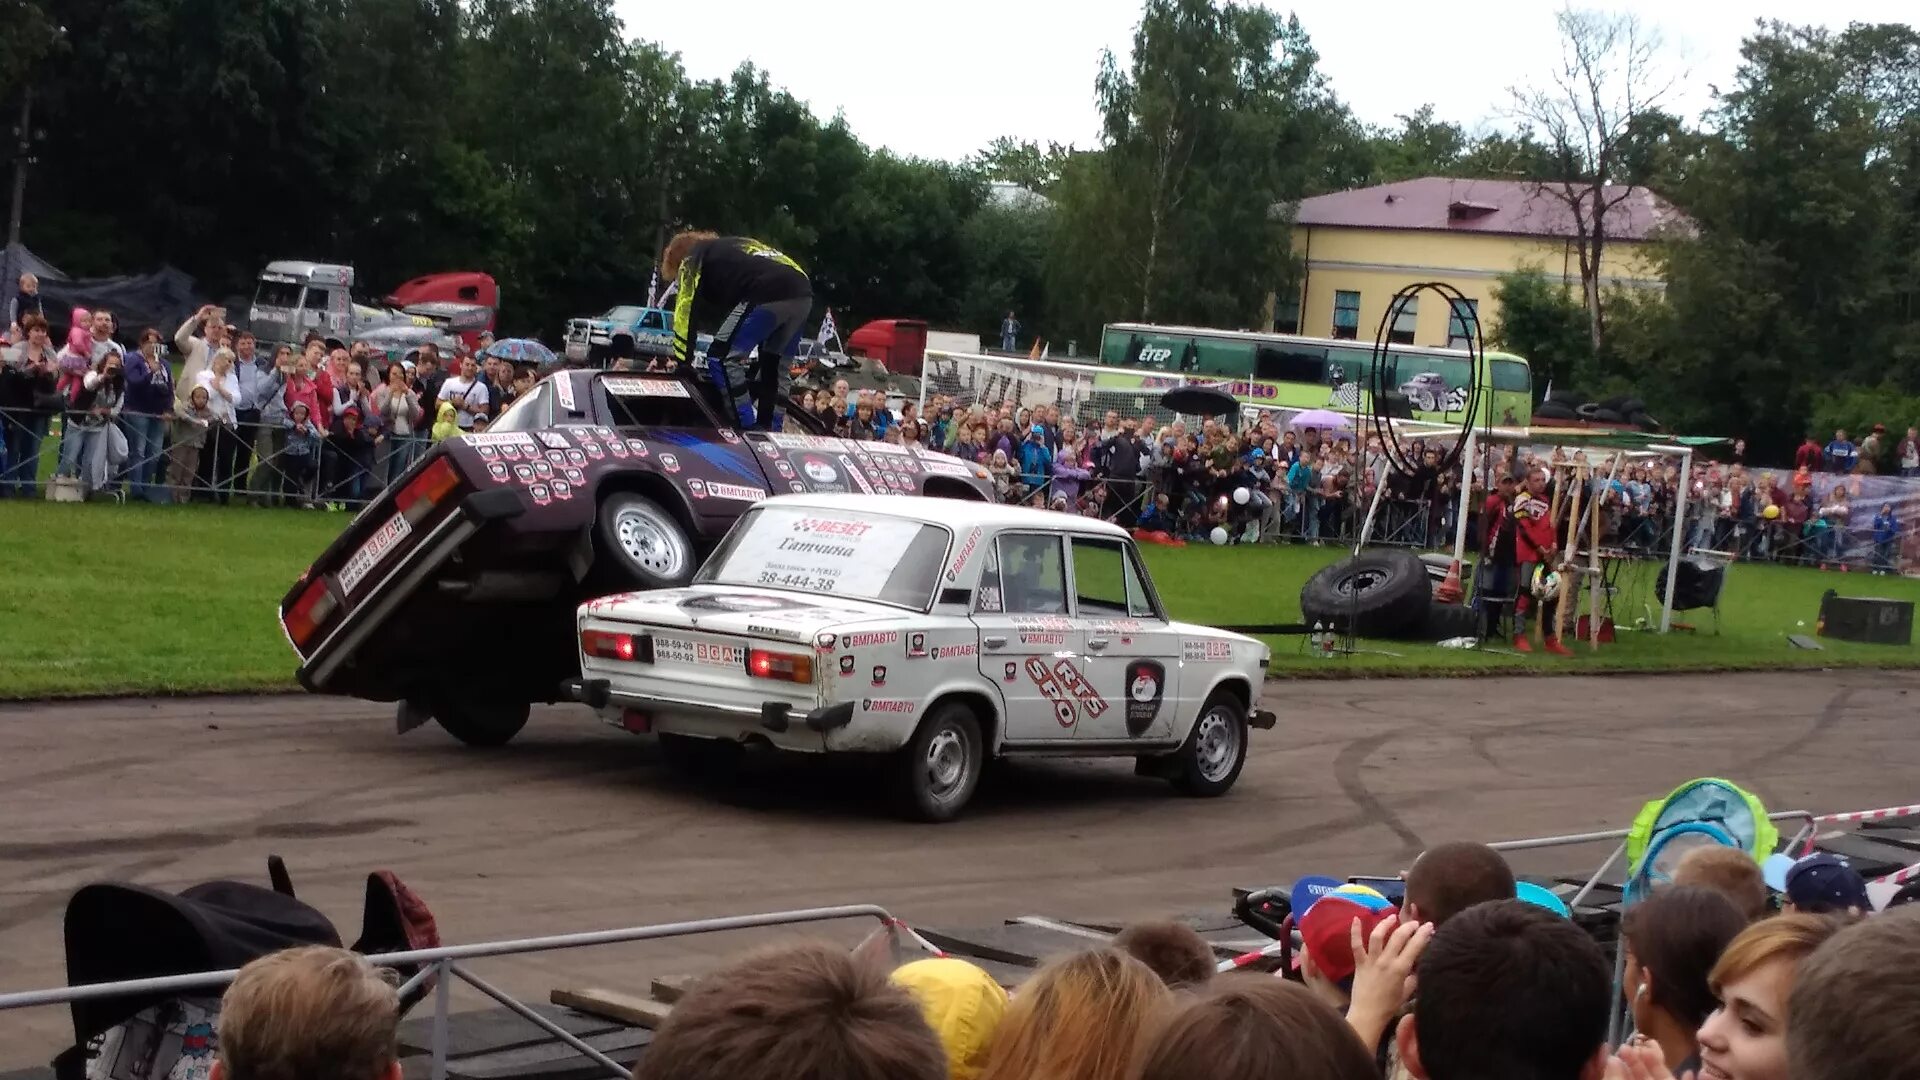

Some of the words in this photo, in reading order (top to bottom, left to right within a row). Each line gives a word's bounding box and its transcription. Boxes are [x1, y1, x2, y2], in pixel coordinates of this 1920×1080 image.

[777, 536, 855, 557] Гатчина
[953, 525, 982, 574] ВМПАВТО
[757, 570, 835, 591] 38-444-38
[852, 631, 897, 647] ВМПАВТО
[871, 700, 914, 714] ВМПАВТО
